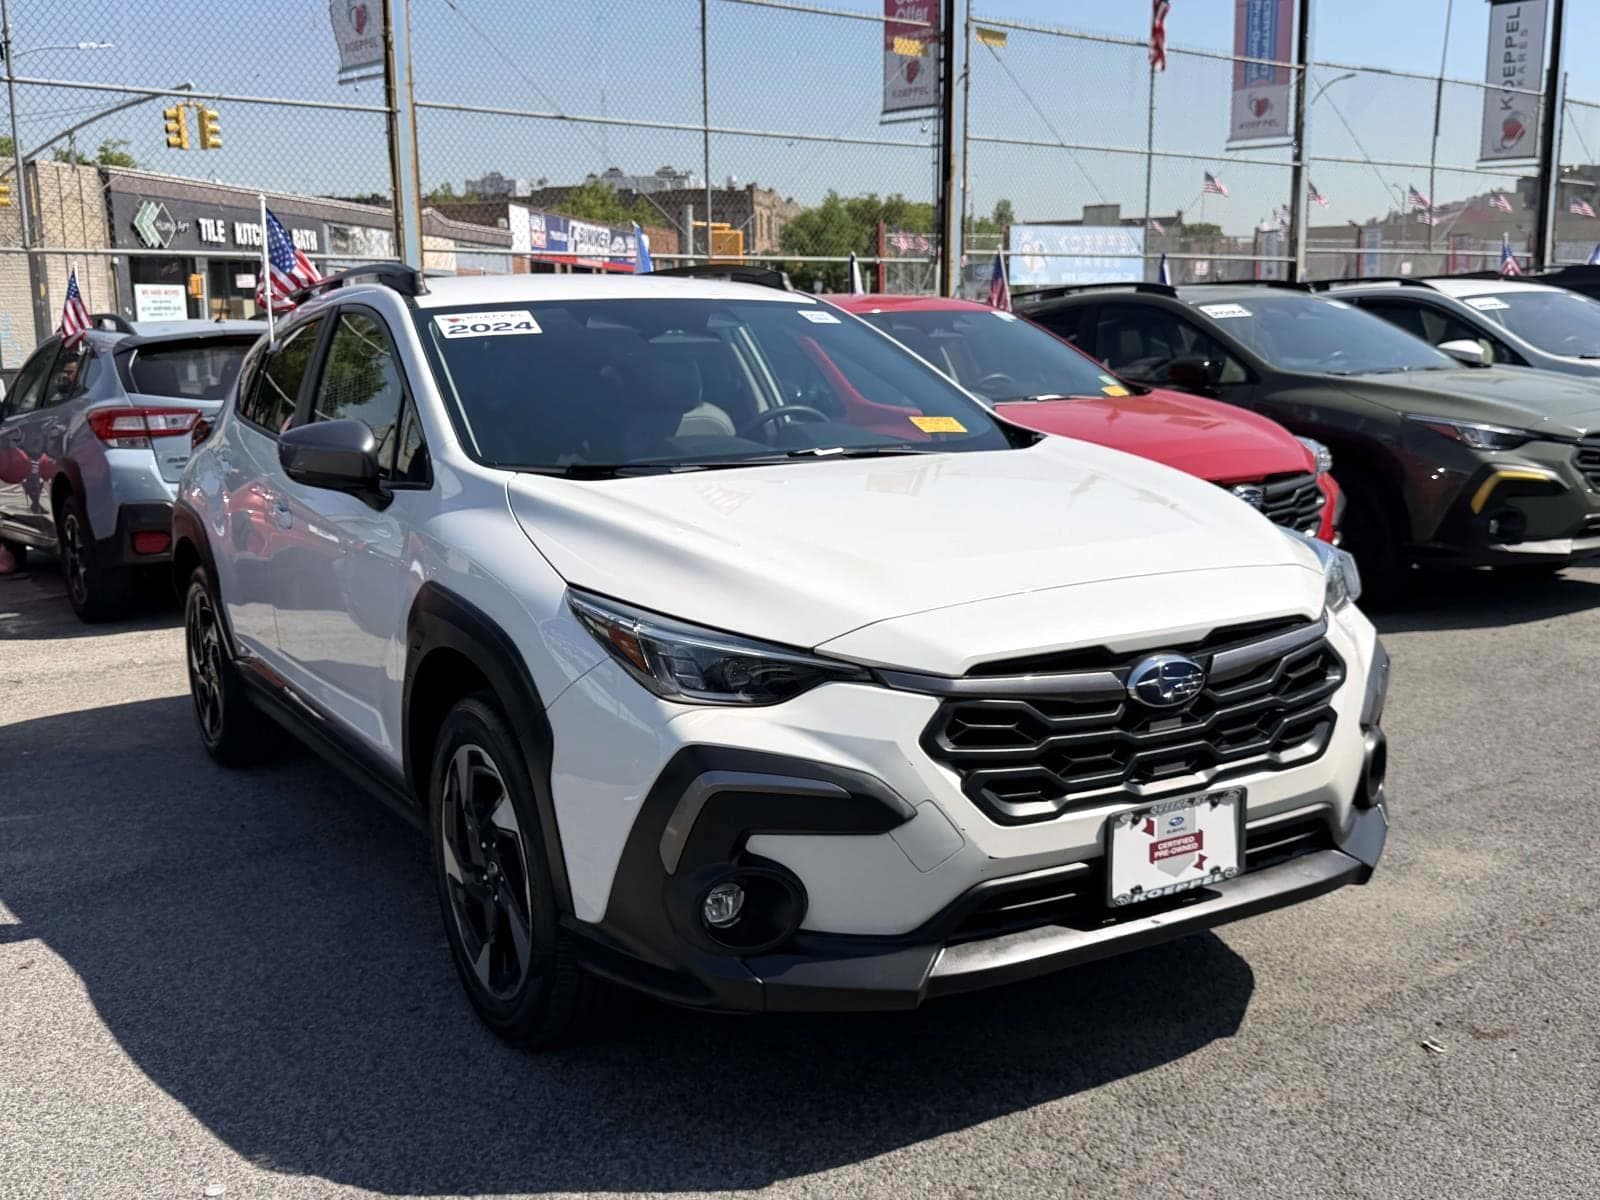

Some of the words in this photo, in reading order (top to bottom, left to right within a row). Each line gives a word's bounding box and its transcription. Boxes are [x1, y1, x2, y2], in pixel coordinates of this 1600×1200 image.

[1500, 6, 1521, 111] KOEPPEL
[197, 217, 226, 243] TILE
[234, 222, 264, 247] KITC
[448, 321, 536, 335] 2024
[1153, 842, 1199, 859] PRE-OWNED
[1157, 836, 1195, 851] CERTIFIED
[1131, 872, 1224, 903] KOEPPEL
